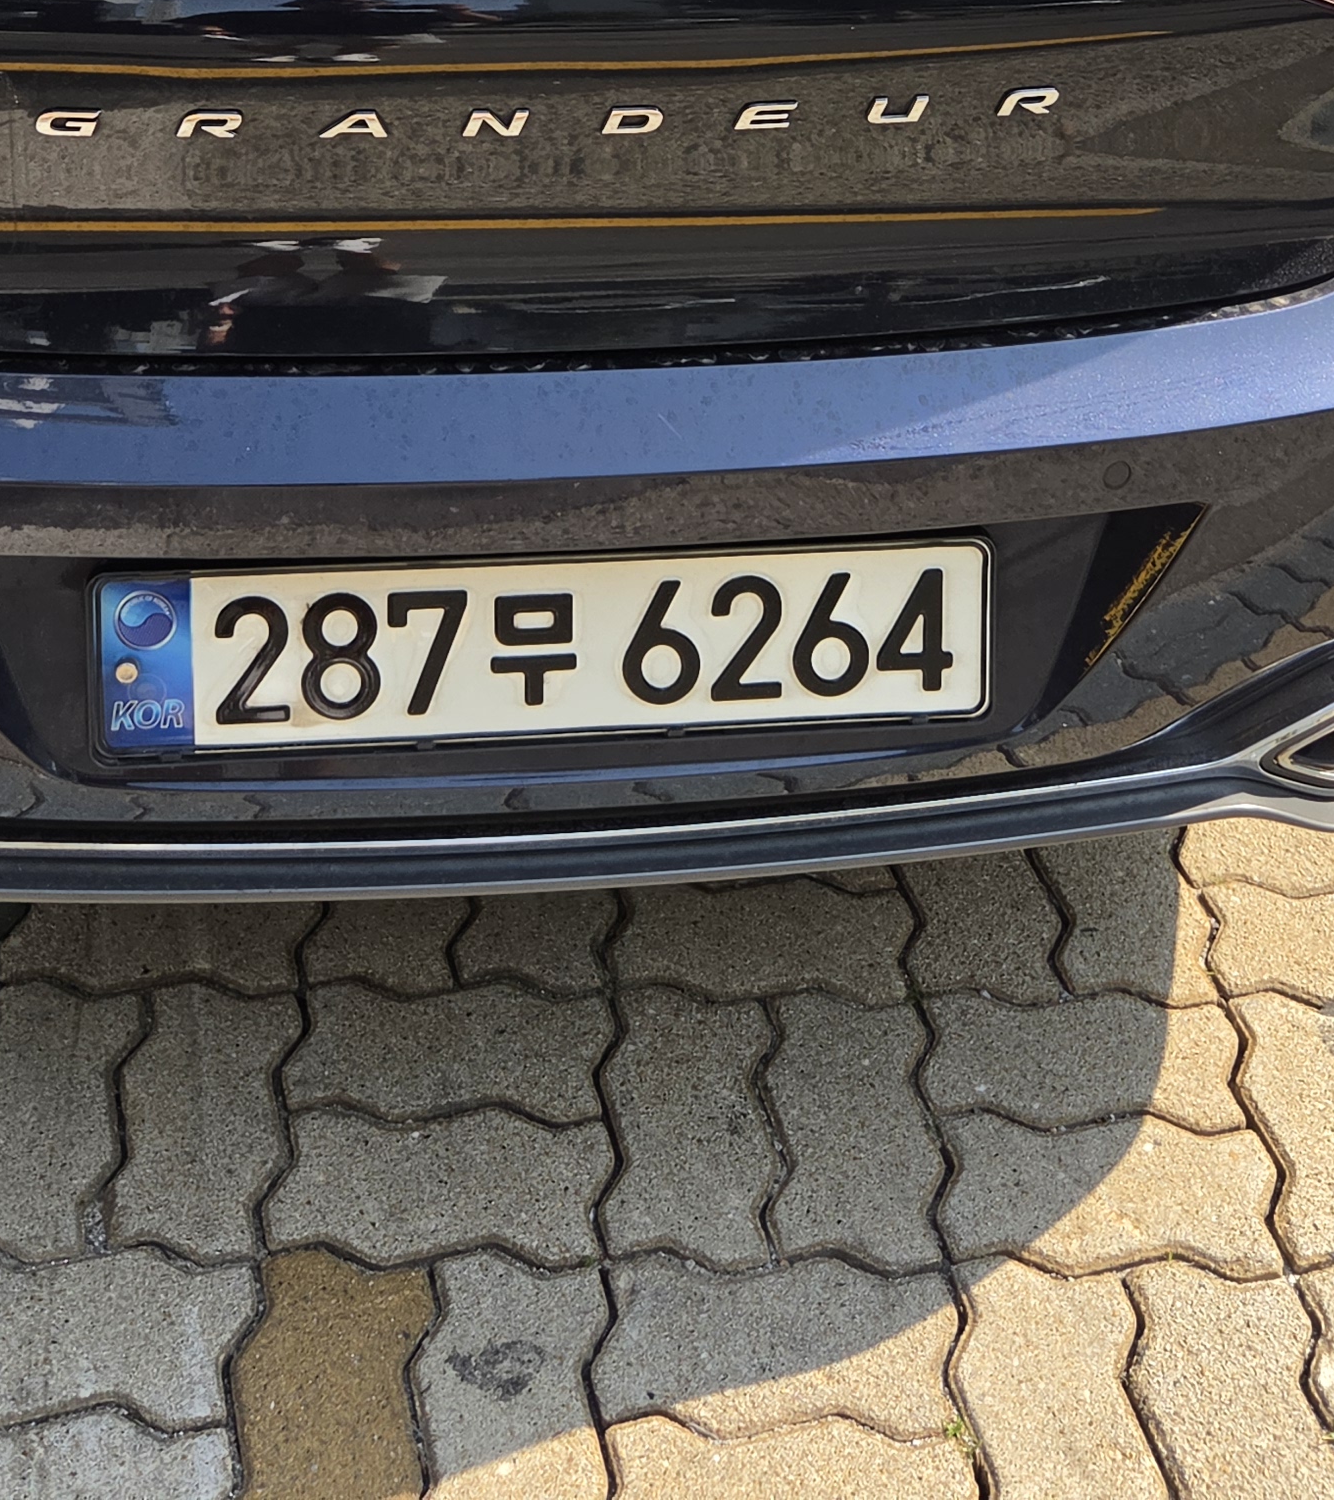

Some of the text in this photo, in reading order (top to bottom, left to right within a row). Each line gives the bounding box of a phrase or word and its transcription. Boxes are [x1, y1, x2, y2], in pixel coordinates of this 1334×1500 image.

[34, 84, 1063, 141] GRANDEUR
[212, 566, 955, 727] 287무 6264
[110, 698, 186, 732] KOR
